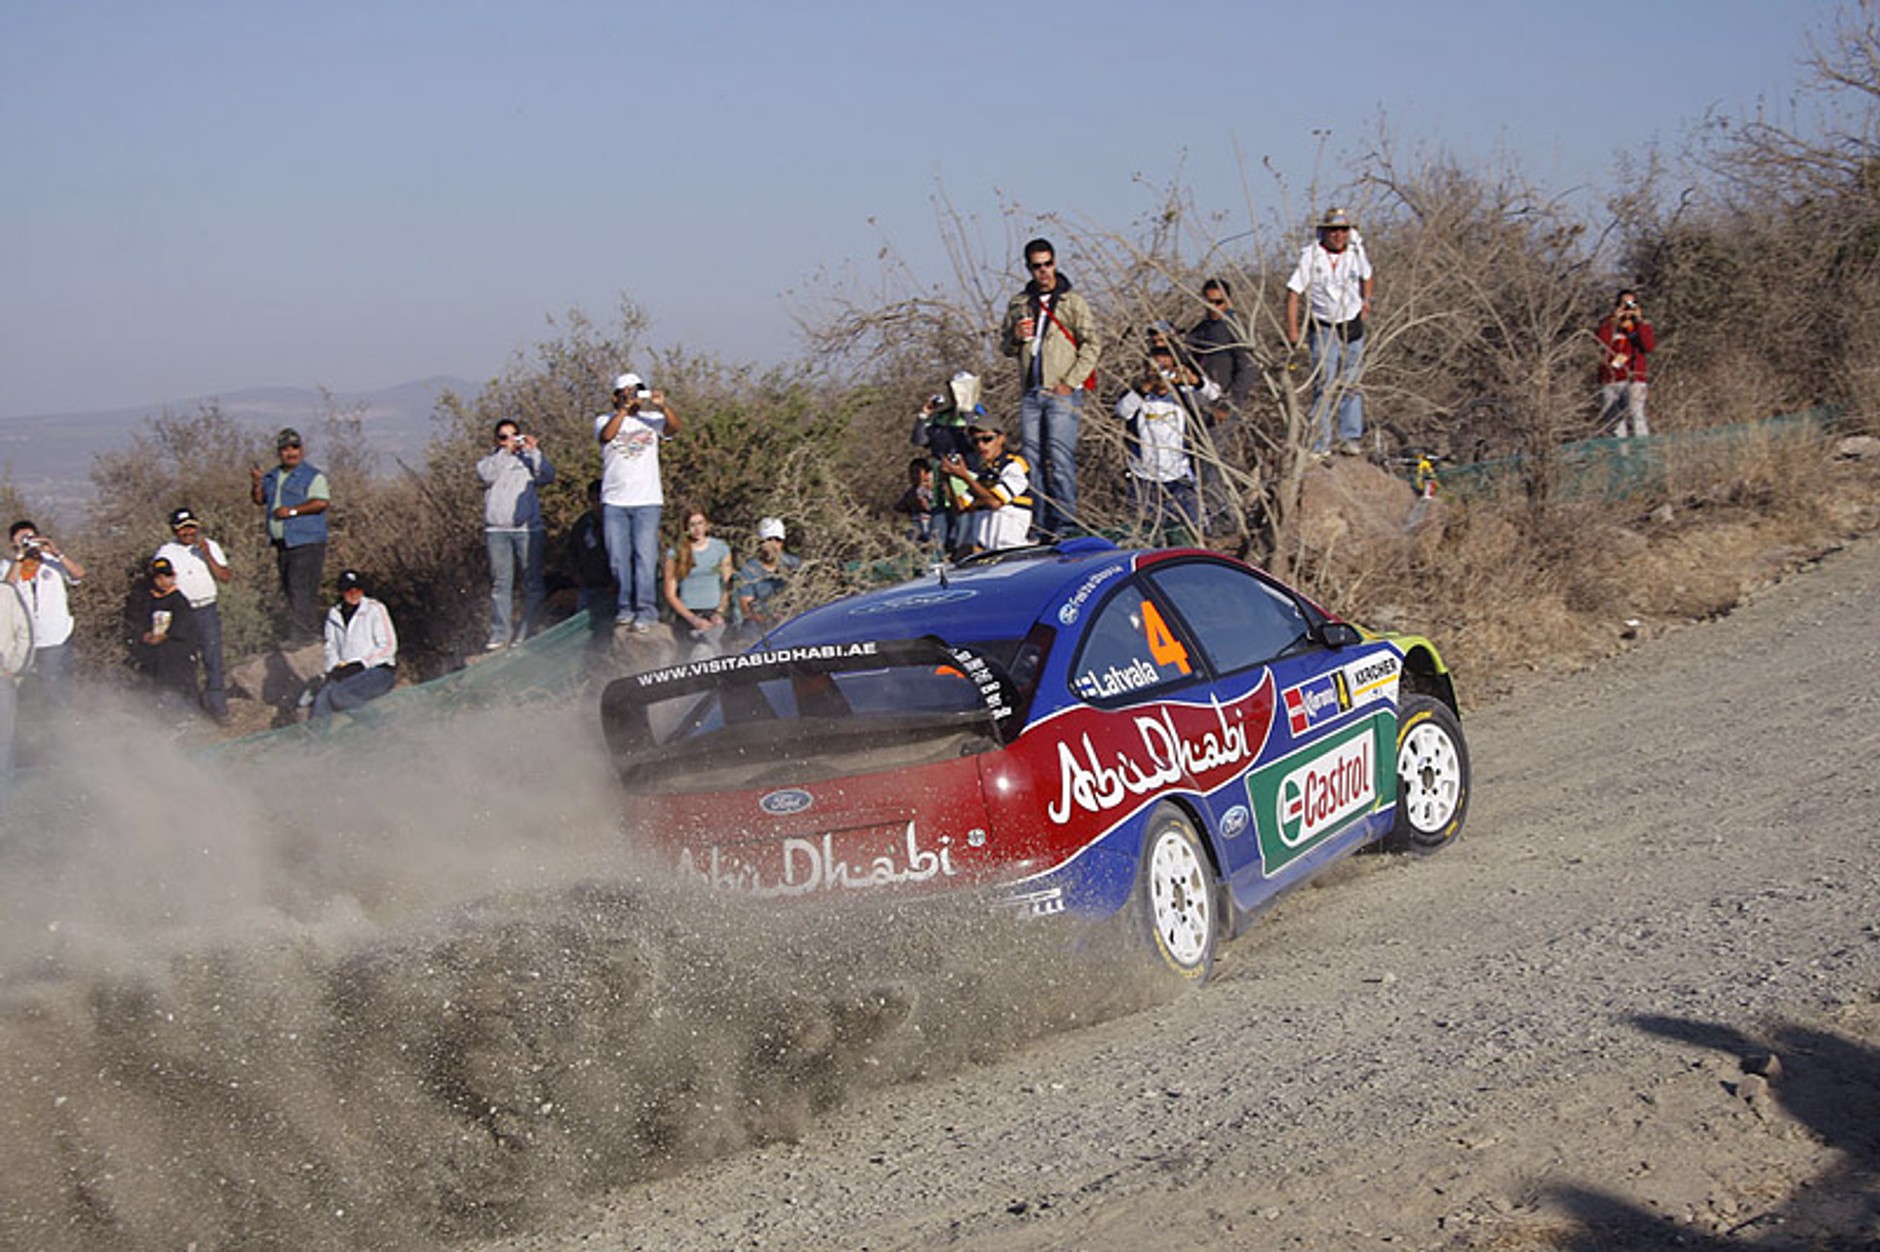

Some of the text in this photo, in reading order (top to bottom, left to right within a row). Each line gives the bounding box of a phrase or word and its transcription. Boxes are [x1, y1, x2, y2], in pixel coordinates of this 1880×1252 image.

[637, 642, 877, 687] WWW.VISITABUDHABI.AE
[1141, 600, 1192, 675] 4
[1088, 657, 1159, 697] Latvala
[1304, 742, 1369, 828] Castrol
[779, 819, 957, 895] Dhabi
